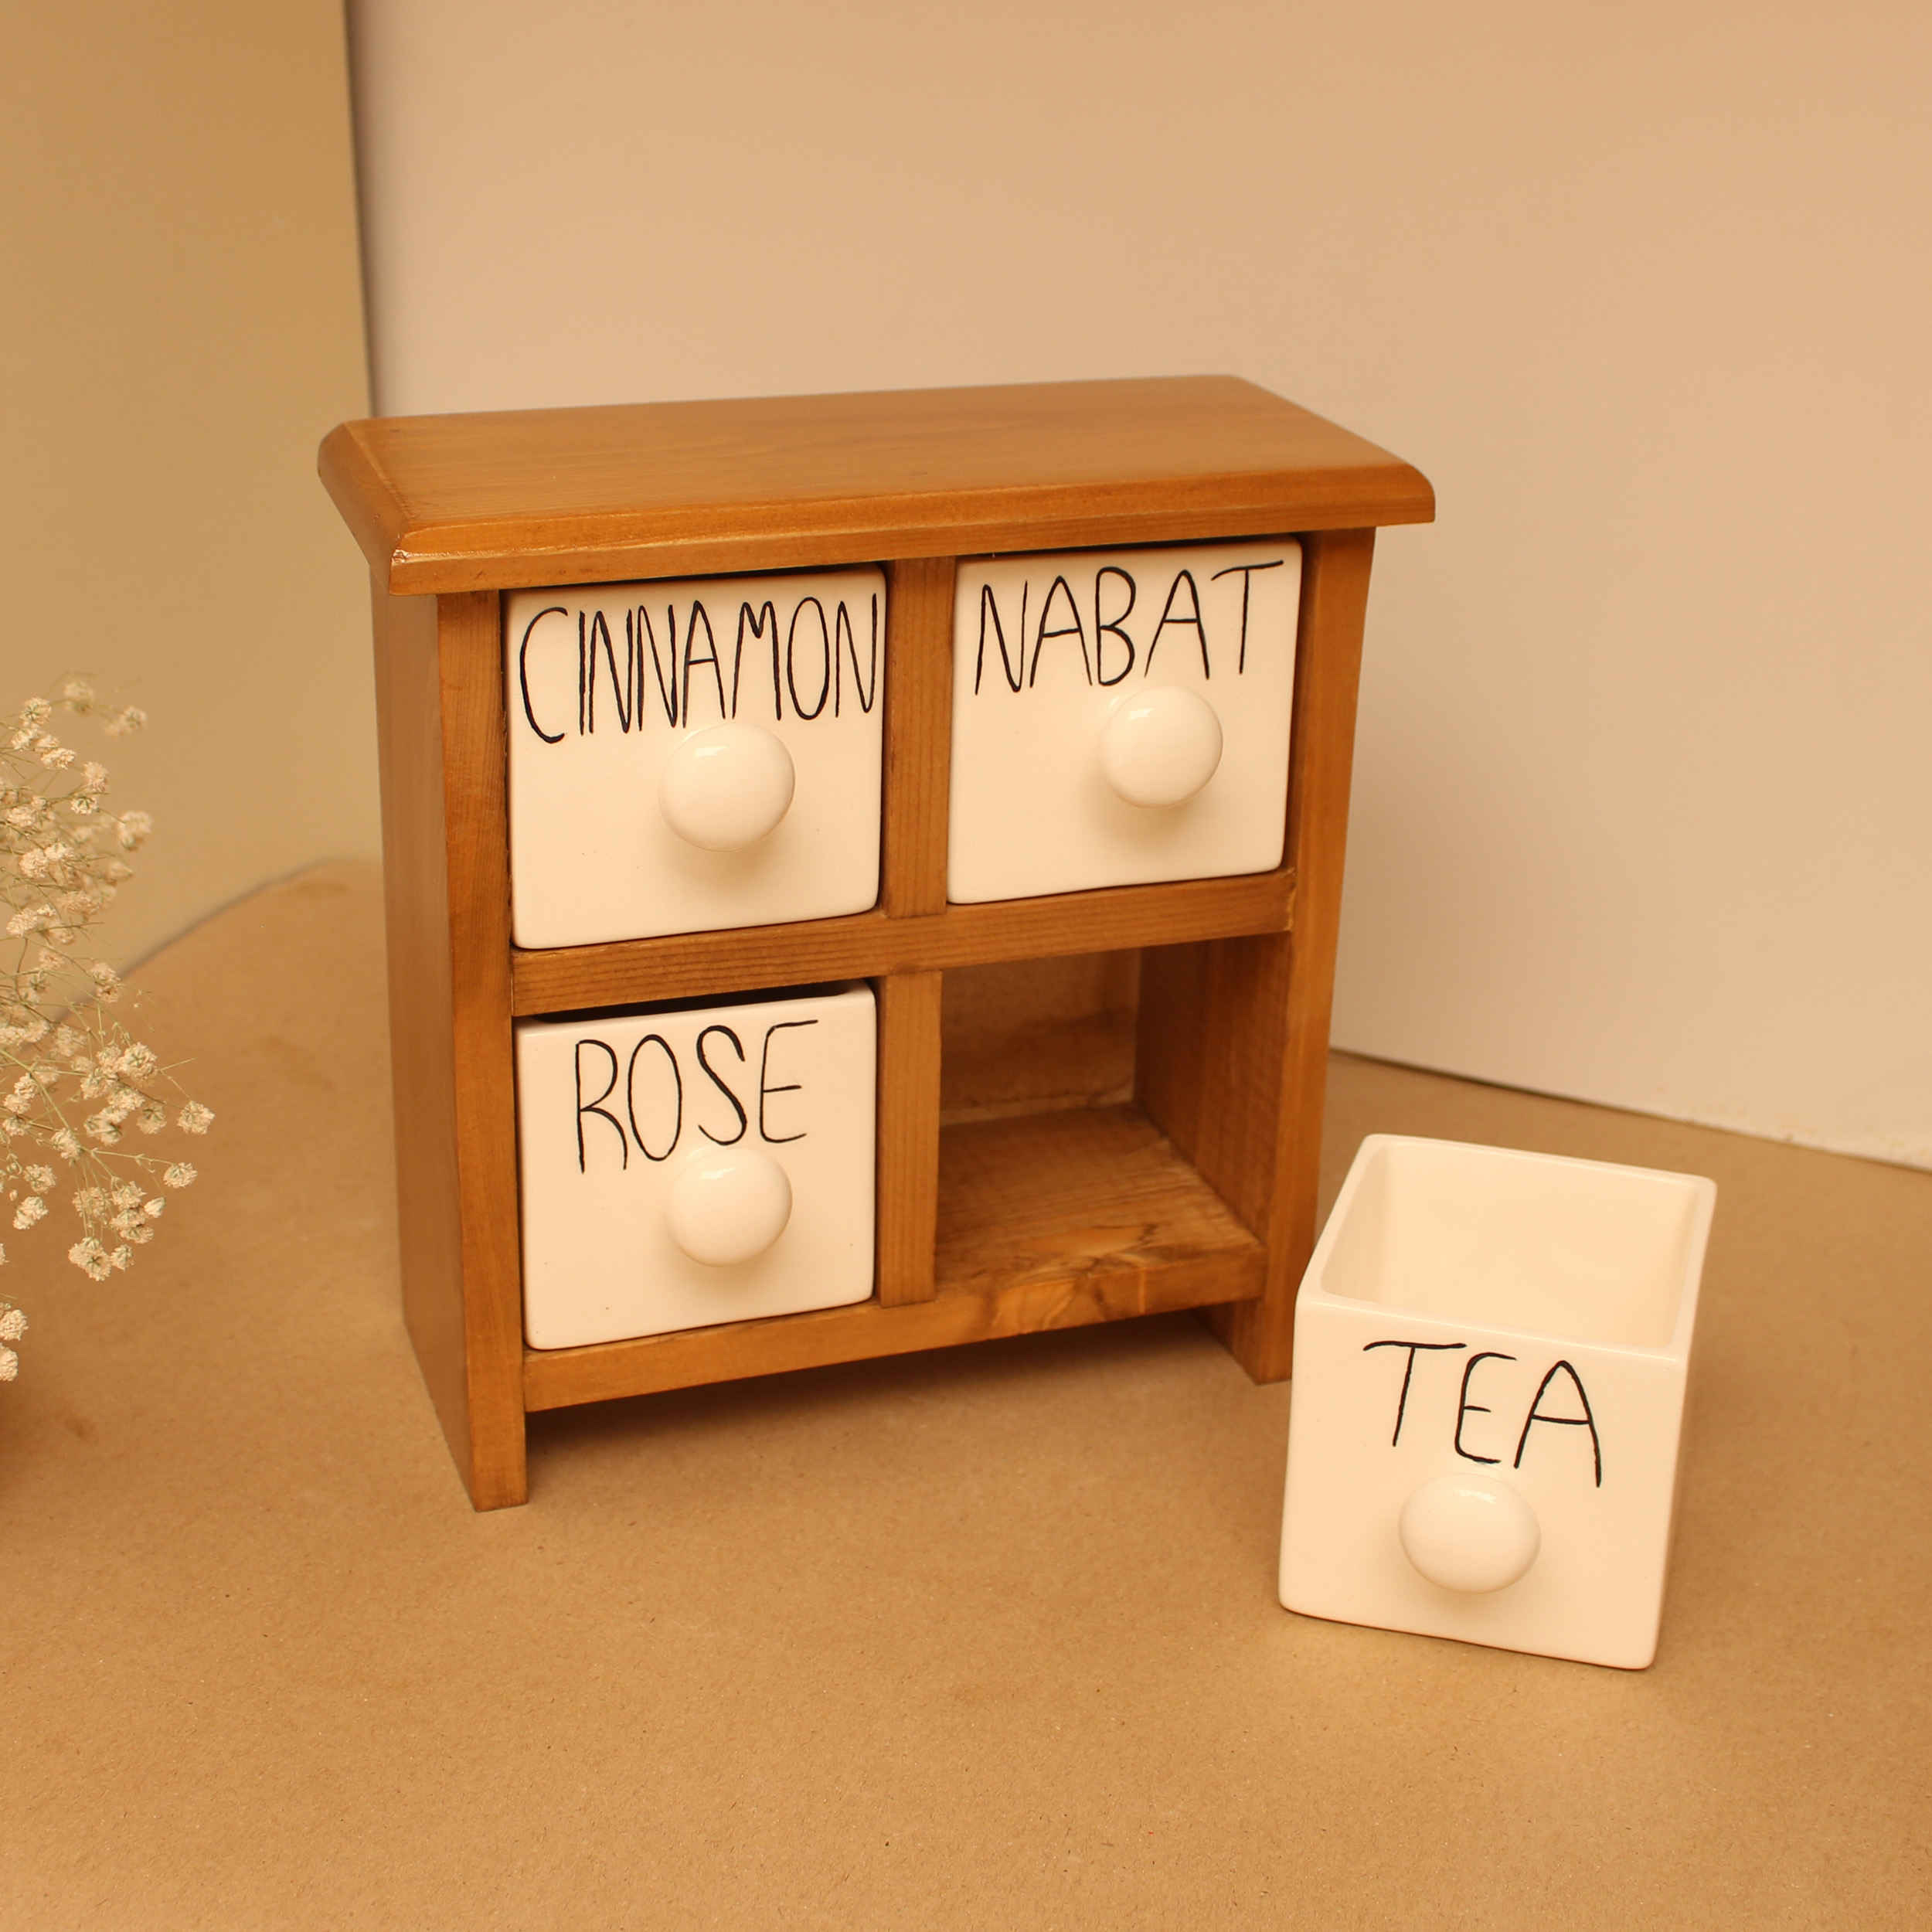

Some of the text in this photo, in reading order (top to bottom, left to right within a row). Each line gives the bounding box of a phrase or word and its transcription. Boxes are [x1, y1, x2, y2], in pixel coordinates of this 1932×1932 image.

[519, 592, 878, 744] CINNAMON
[975, 559, 1284, 696] NABAT
[575, 1019, 818, 1174] ROSE
[1362, 1340, 1602, 1488] TEA
